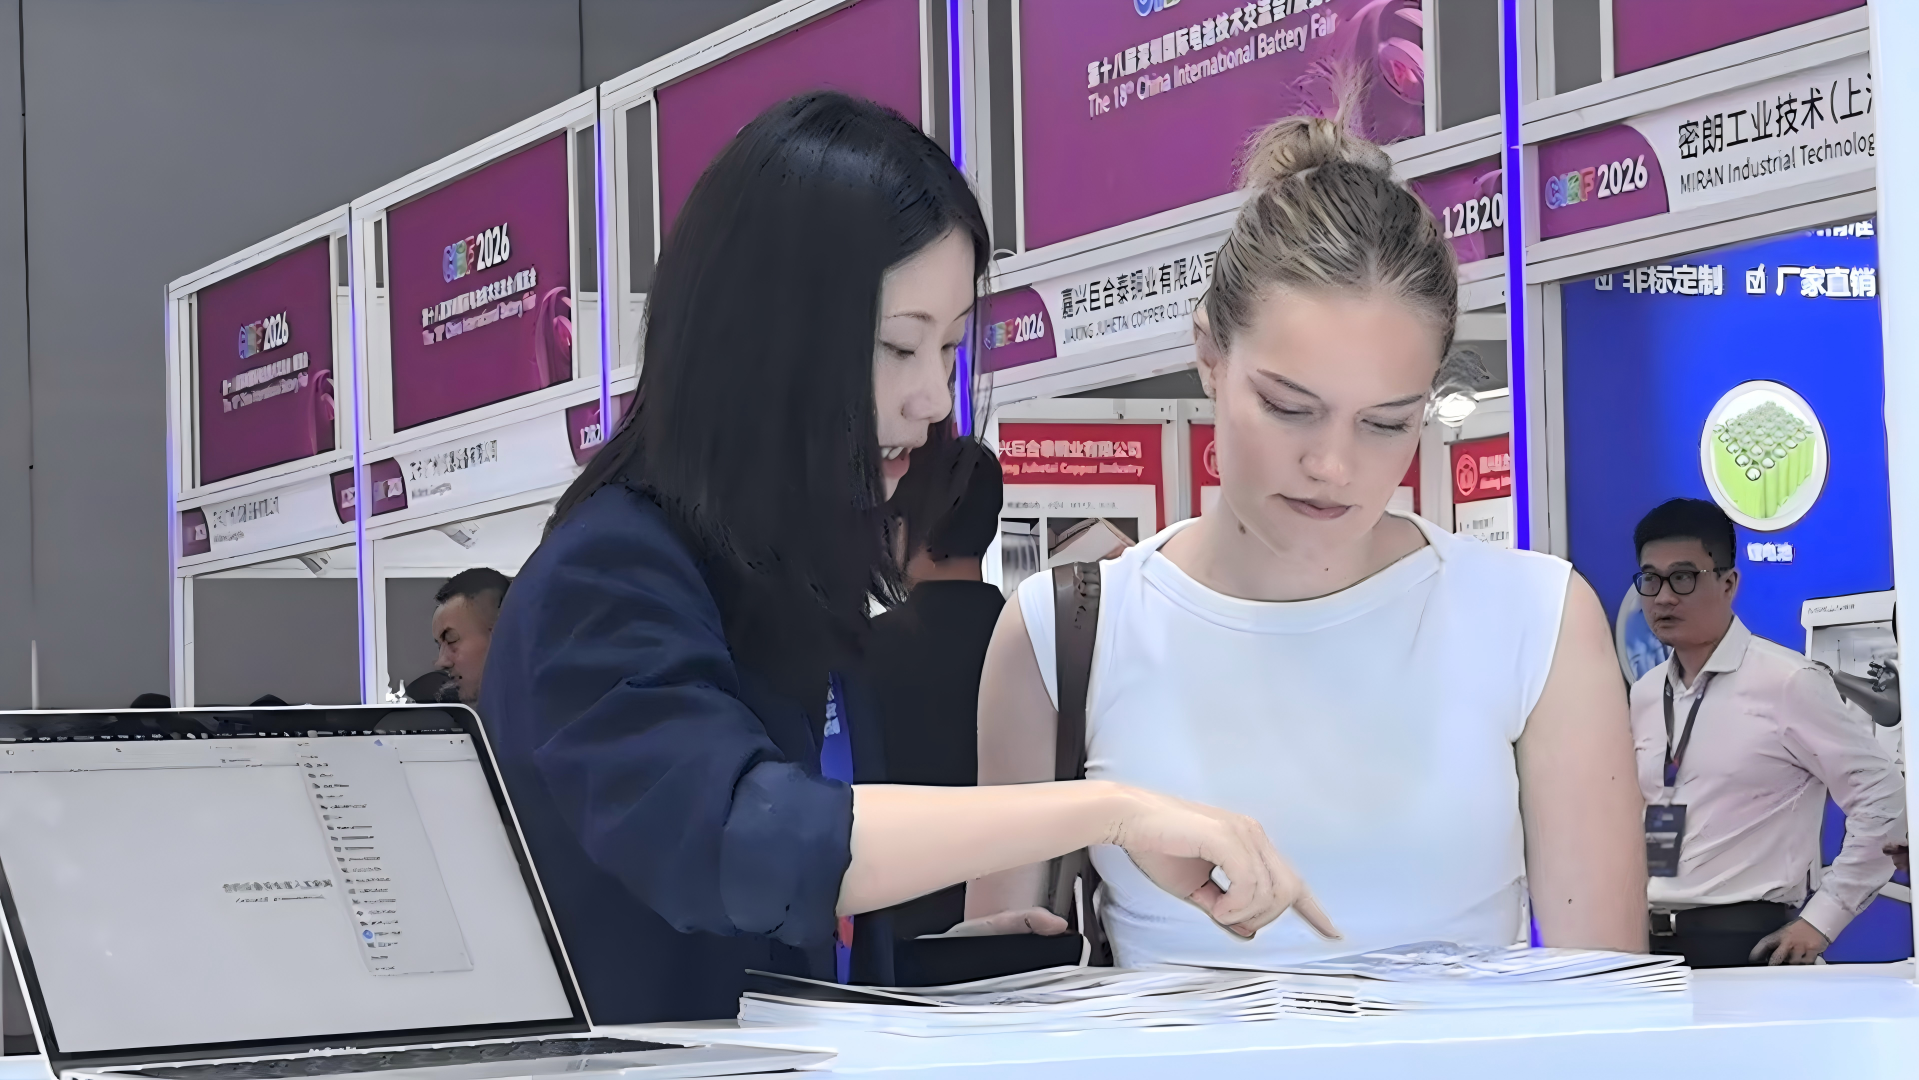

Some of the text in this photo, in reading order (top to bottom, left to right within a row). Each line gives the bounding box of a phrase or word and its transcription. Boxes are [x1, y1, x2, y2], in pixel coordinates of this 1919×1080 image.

[1088, 92, 1111, 117] The
[1173, 45, 1256, 88] International
[1257, 23, 1308, 59] Battery
[1310, 7, 1339, 39] Fair
[1597, 154, 1648, 200] 2026
[1680, 165, 1724, 195] MIRAN
[1728, 146, 1796, 184] Industrial
[476, 222, 510, 271] 2026
[1623, 264, 1723, 297] 非标定制
[1775, 265, 1877, 298] 厂家直销
[1014, 310, 1045, 343] 2026
